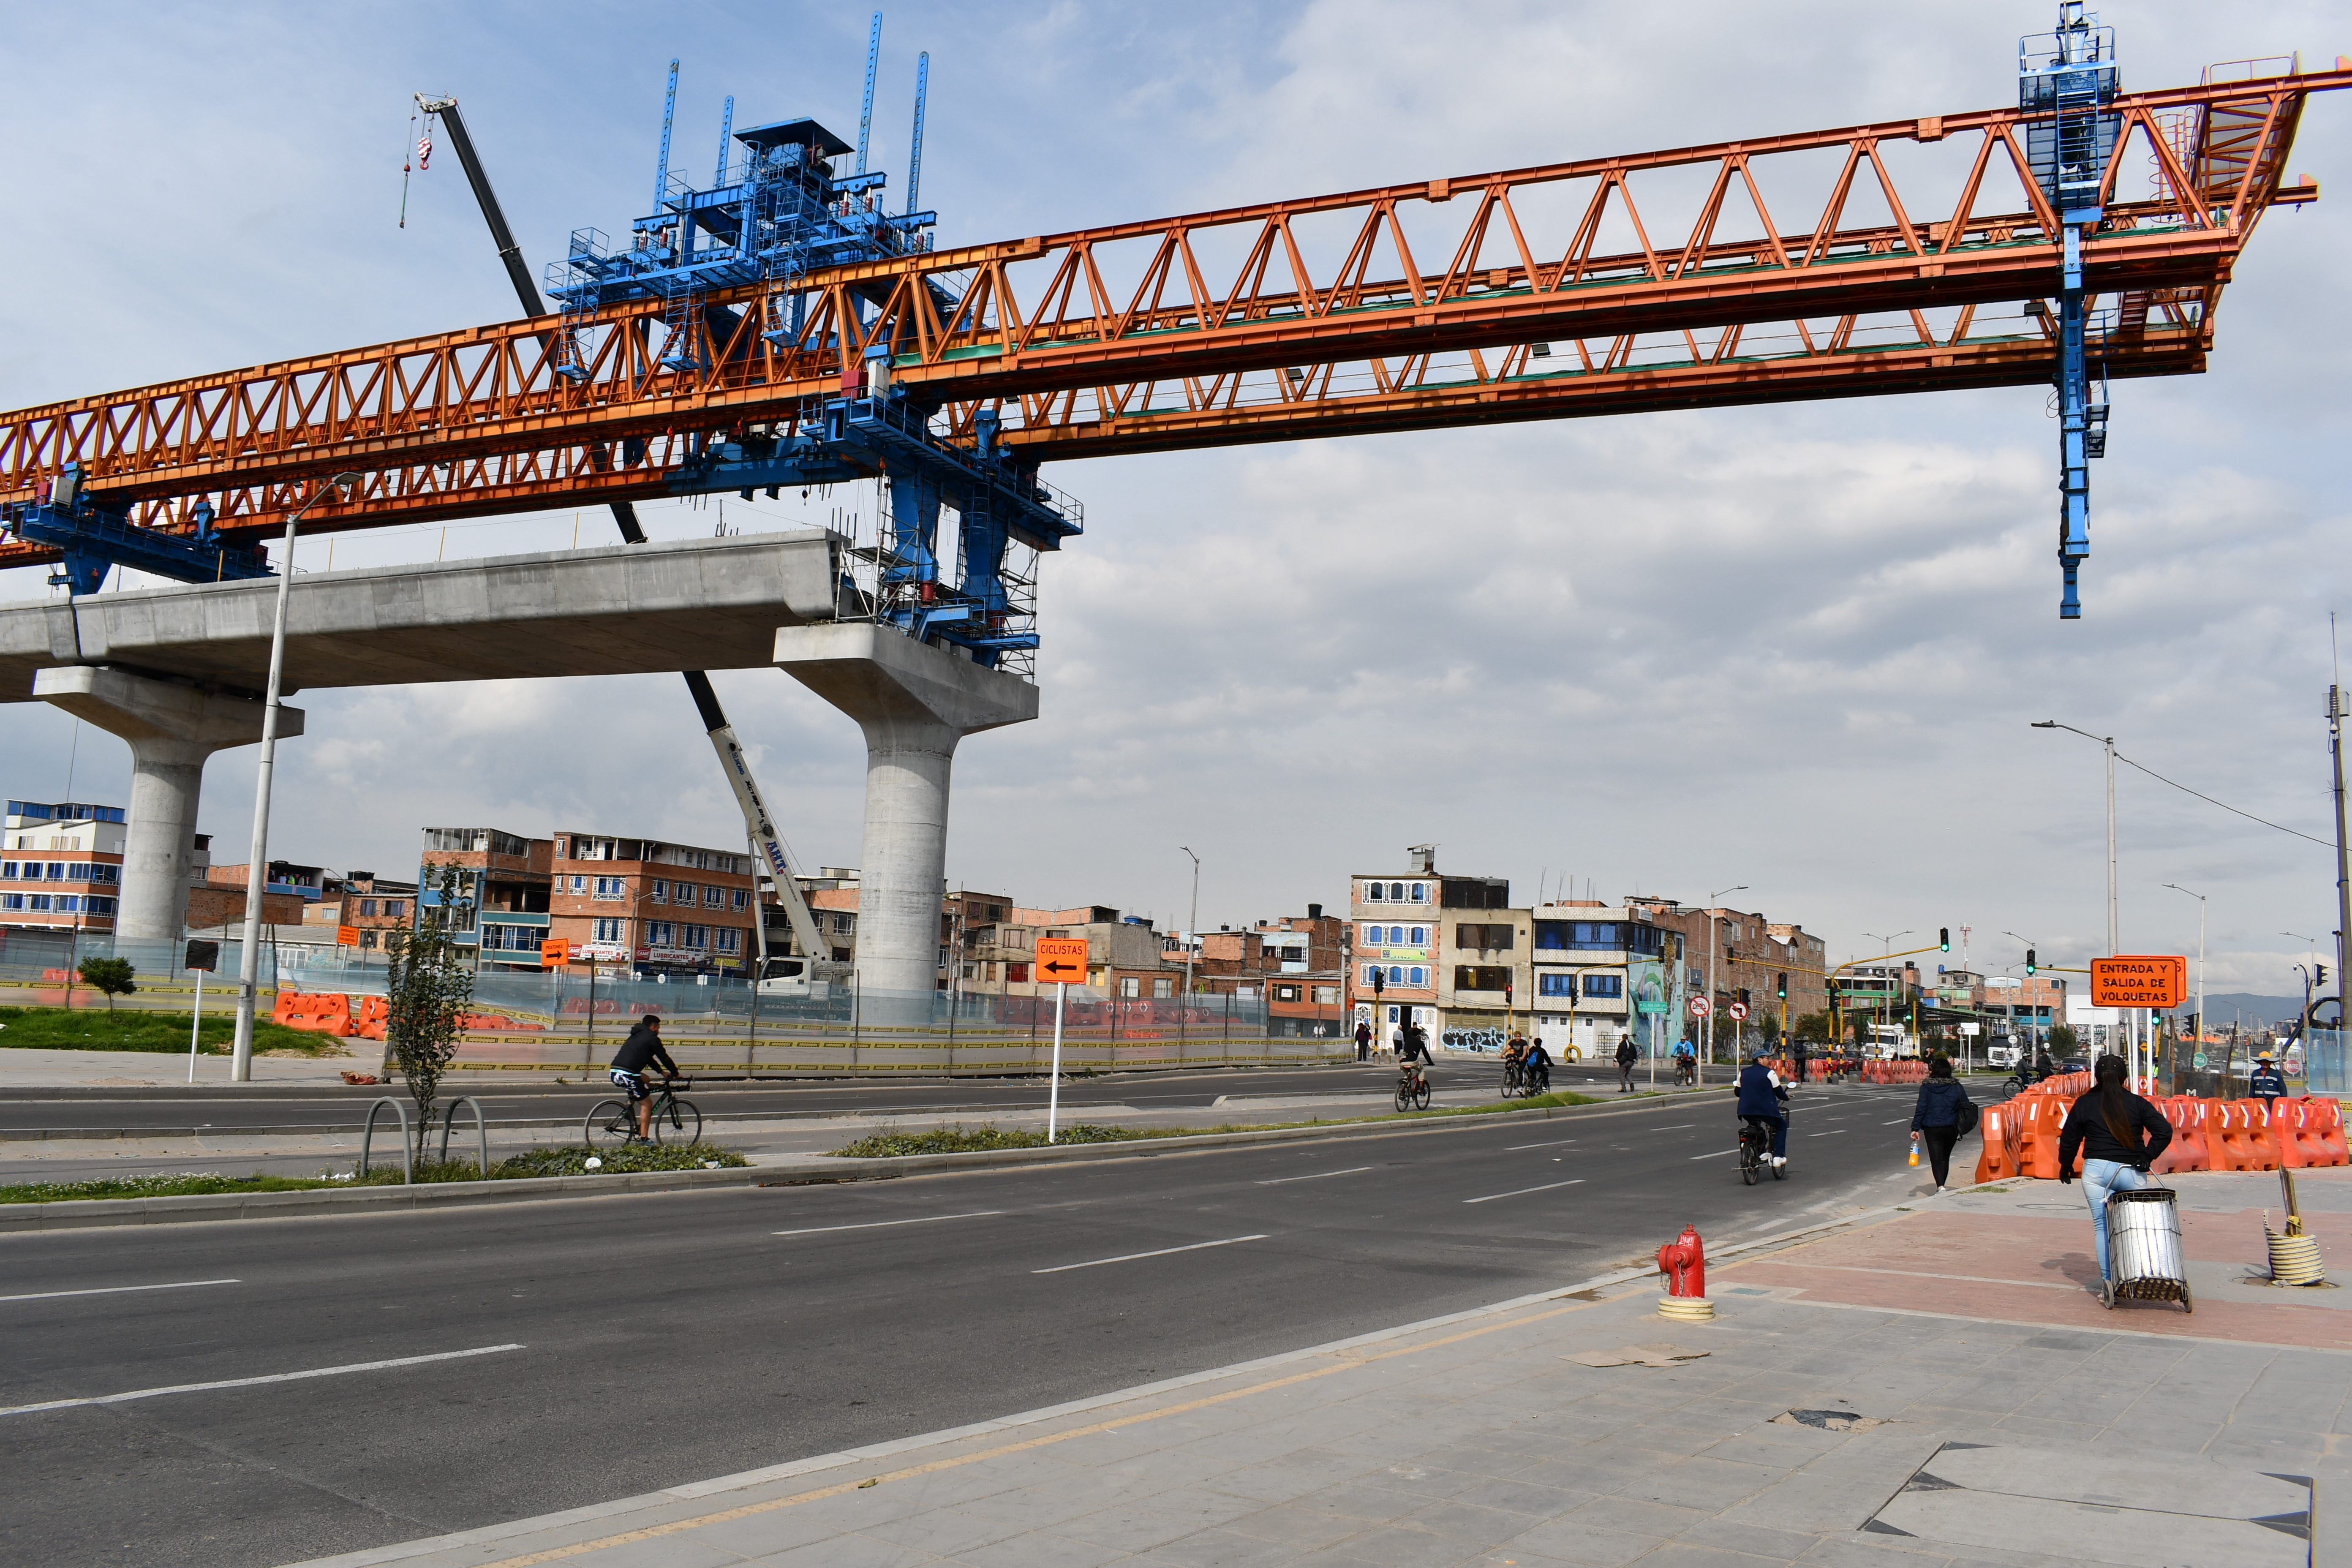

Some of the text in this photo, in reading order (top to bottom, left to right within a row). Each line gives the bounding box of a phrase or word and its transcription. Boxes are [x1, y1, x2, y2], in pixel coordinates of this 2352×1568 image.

[734, 758, 745, 775] XCMG
[768, 841, 787, 868] AHT
[1040, 945, 1082, 955] CICLISTAS
[713, 957, 740, 967] RAADORES
[2100, 964, 2153, 973] ENTRADA
[2159, 965, 2167, 973] Y
[2103, 978, 2165, 988] SALIDA DE
[2100, 992, 2167, 1002] VOLQUETAS
